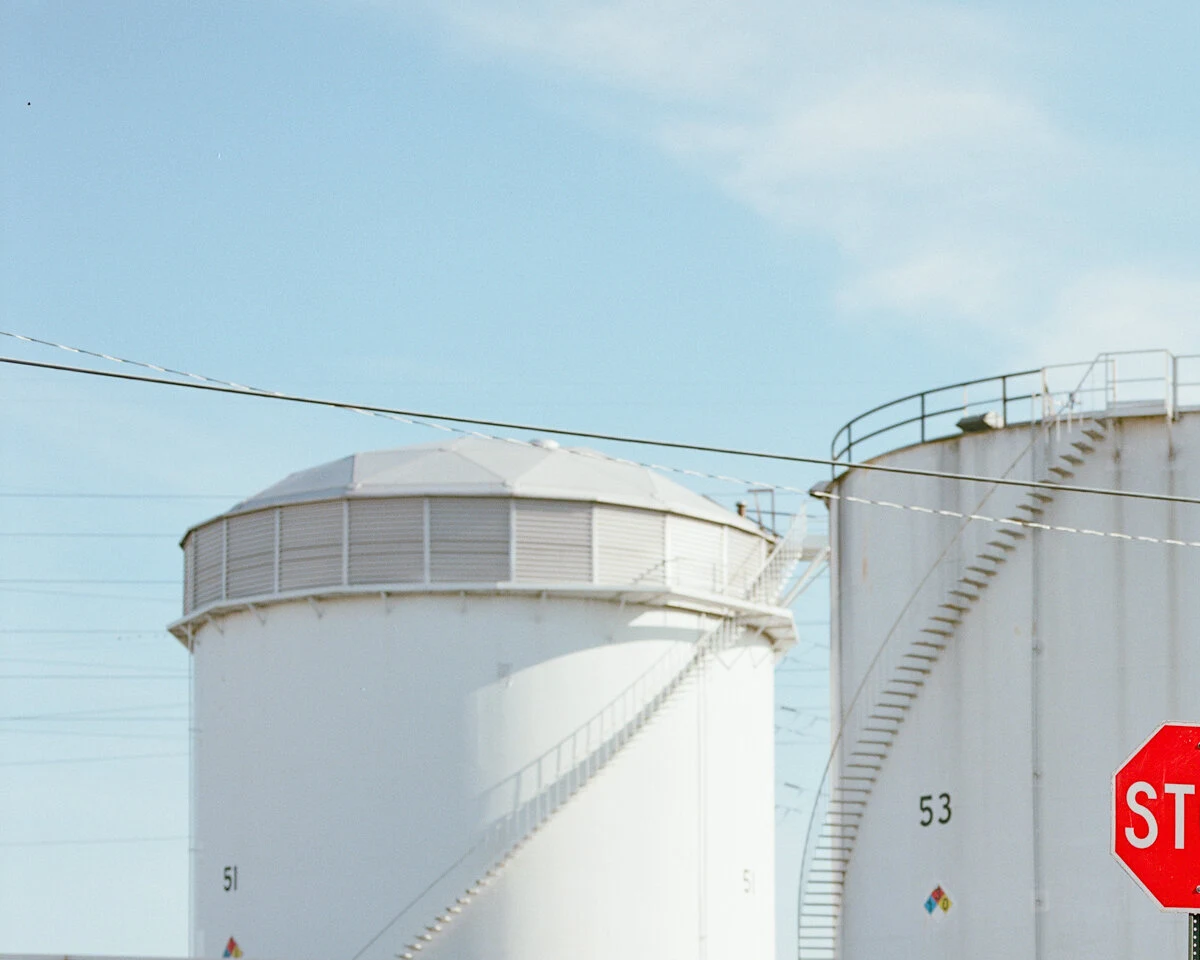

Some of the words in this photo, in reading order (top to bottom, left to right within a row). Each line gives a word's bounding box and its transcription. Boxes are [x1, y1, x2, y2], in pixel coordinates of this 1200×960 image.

[920, 793, 952, 827] 53
[223, 866, 238, 891] 51
[743, 868, 756, 896] 51
